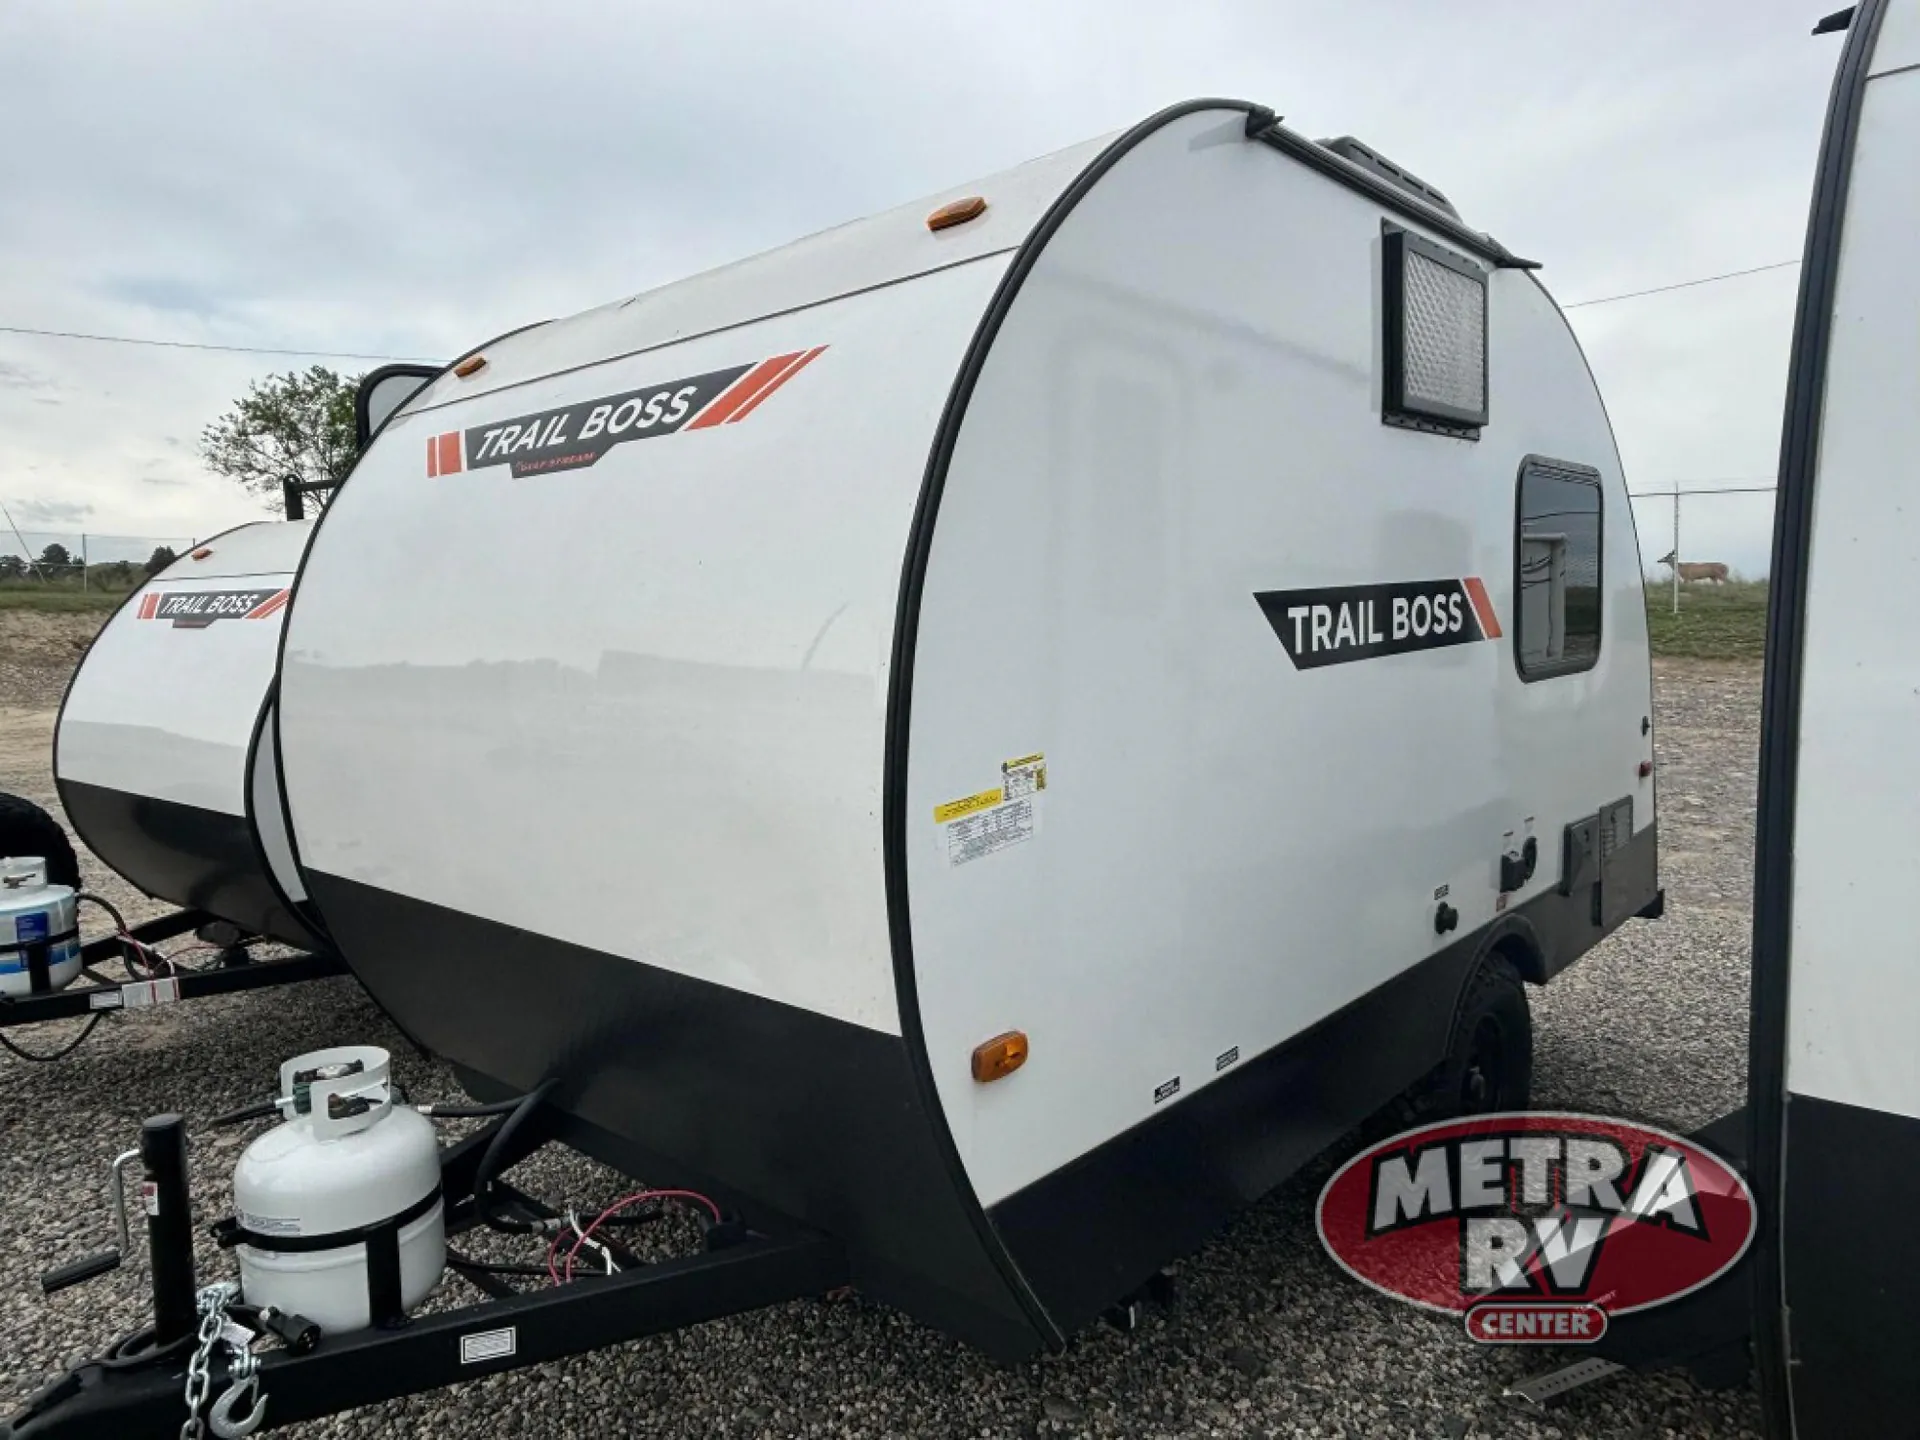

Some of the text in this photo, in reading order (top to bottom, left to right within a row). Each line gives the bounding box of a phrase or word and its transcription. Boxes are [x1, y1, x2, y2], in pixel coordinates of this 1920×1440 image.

[475, 385, 699, 460] TRAIL BOSS
[161, 594, 259, 614] TRAIL BOSS
[1287, 592, 1464, 654] TRAIL BOSS
